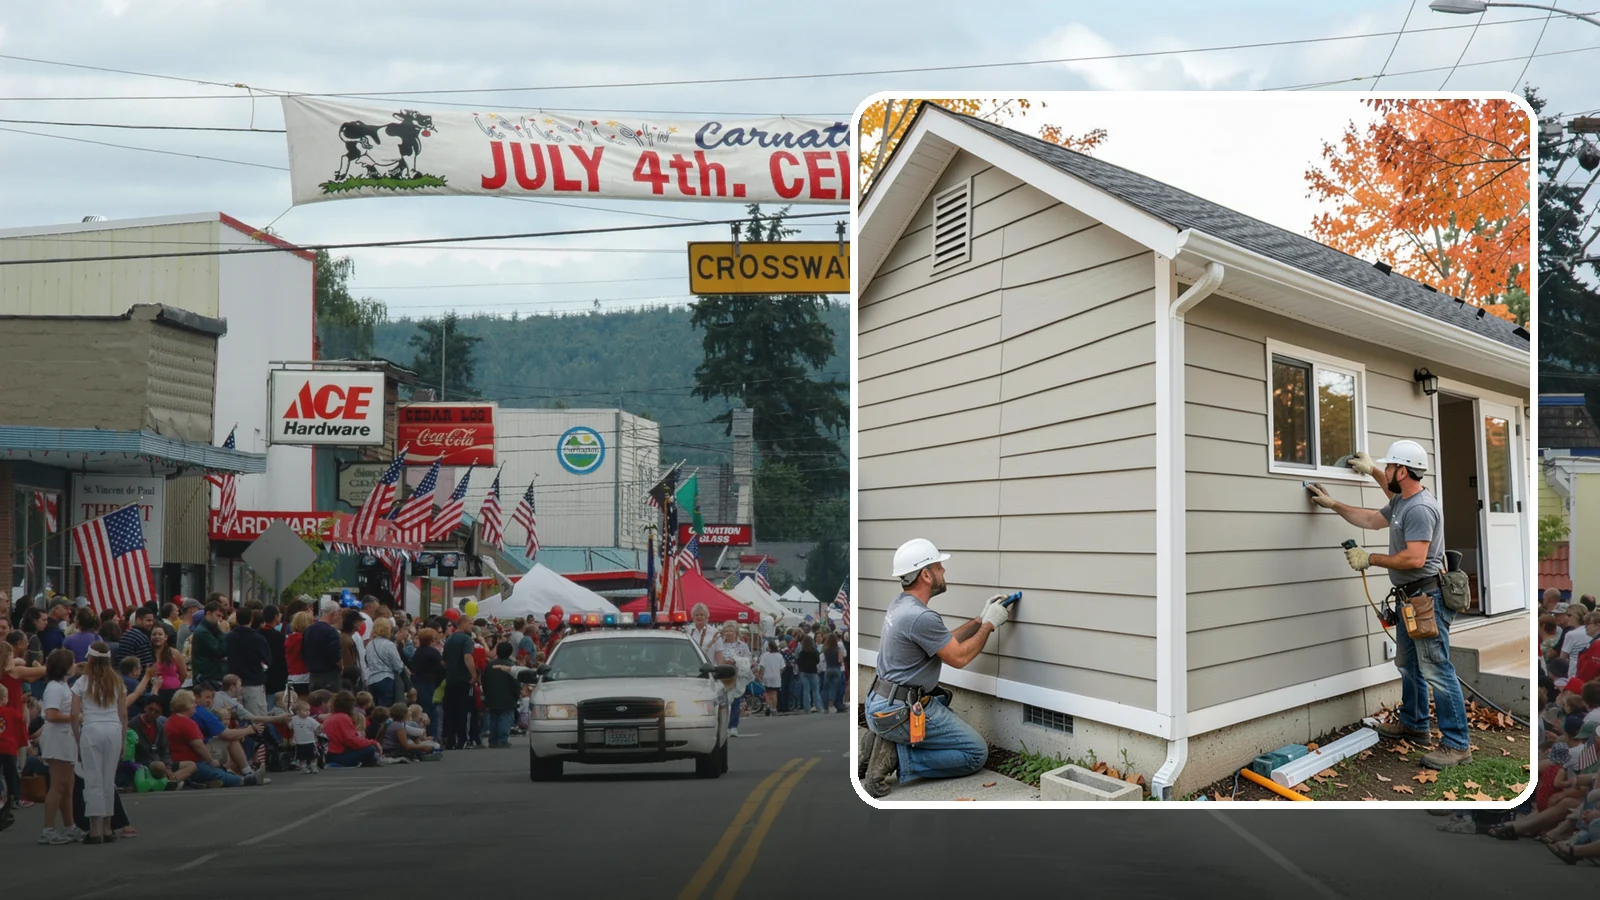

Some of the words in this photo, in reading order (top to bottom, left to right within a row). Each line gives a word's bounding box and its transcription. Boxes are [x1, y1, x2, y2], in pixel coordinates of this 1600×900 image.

[695, 121, 850, 150] Carnat
[481, 140, 605, 193] JULY
[632, 150, 747, 198] 4th.
[697, 254, 850, 280] CROSSWA
[282, 379, 374, 420] ACE
[406, 409, 452, 422] CEDAR
[461, 409, 485, 422] LOG
[283, 421, 371, 437] Hardware
[416, 428, 477, 447] Coca-Cola
[95, 485, 124, 494] Vincent
[126, 485, 136, 494] de
[138, 486, 155, 495] Paul
[688, 526, 742, 535] CRNATION
[699, 535, 731, 544] GLASS
